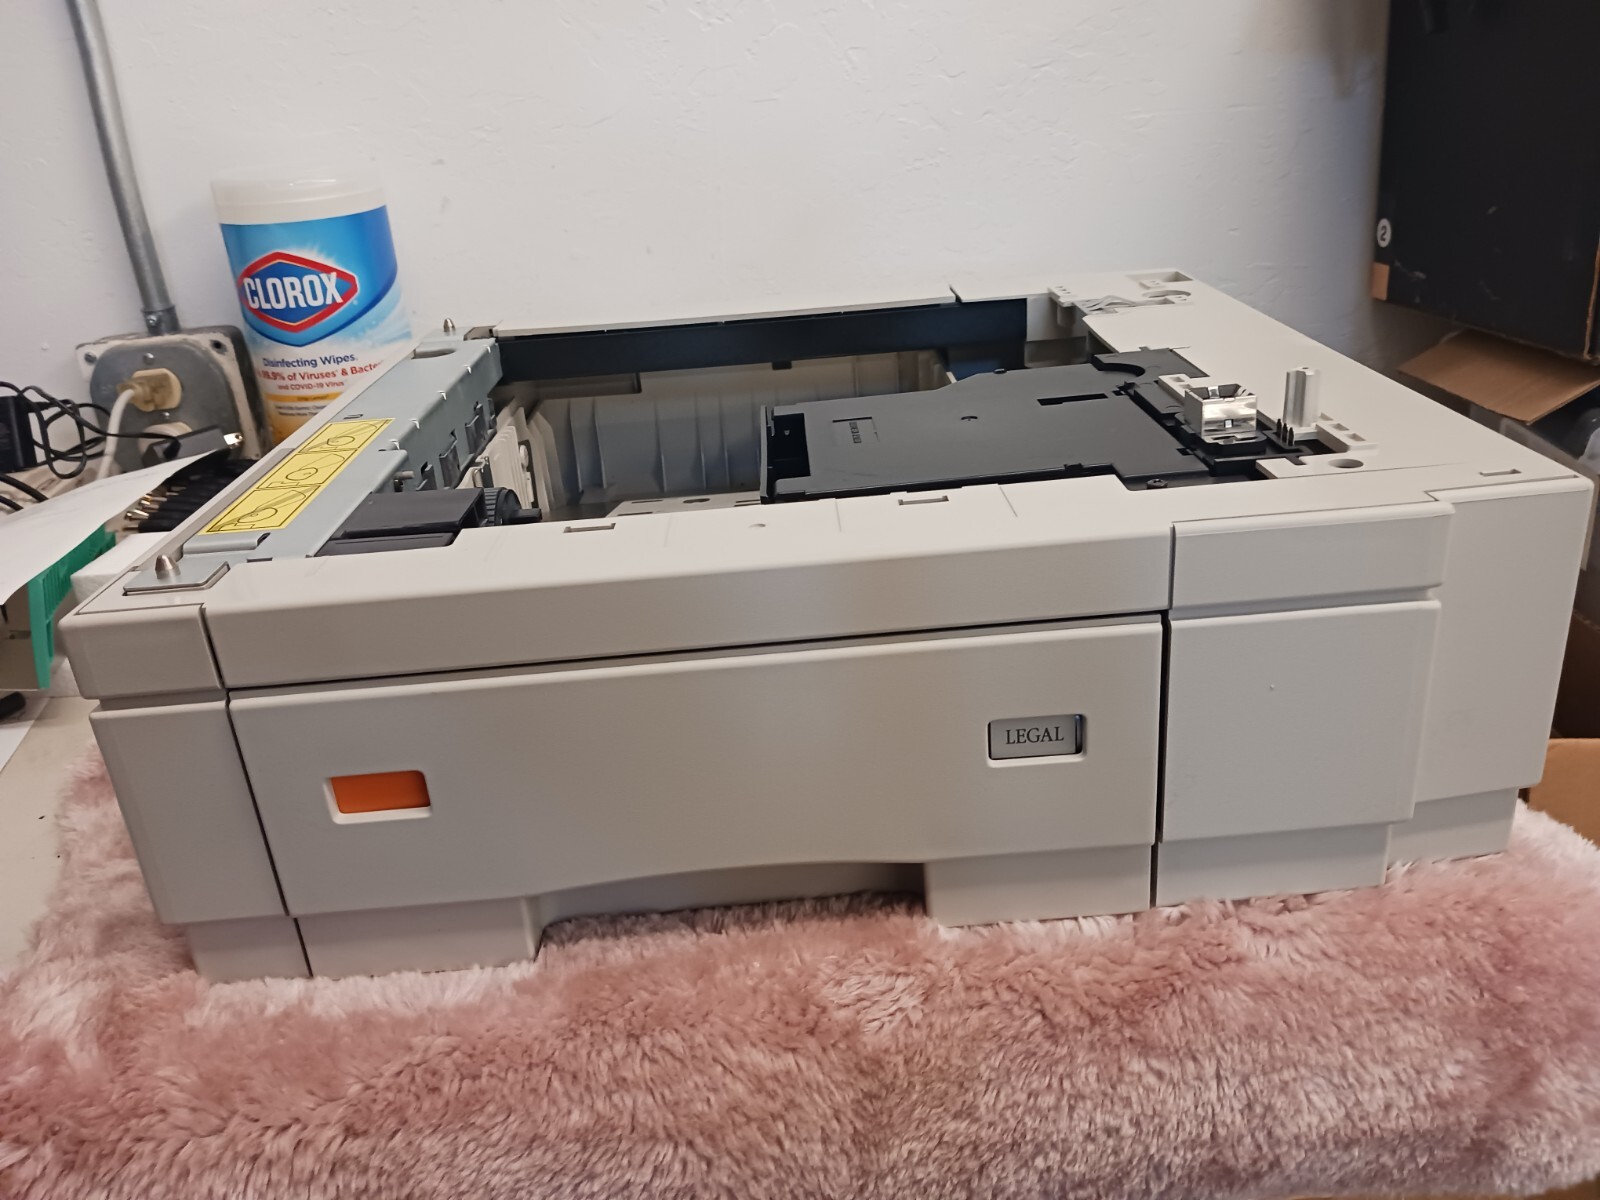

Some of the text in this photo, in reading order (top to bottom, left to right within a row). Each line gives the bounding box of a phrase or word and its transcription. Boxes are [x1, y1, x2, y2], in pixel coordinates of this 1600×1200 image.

[243, 271, 343, 310] CLOROX
[262, 353, 356, 368] Disinfecting Wipes
[287, 372, 297, 381] of
[341, 368, 349, 376] &
[290, 382, 324, 391] COVID-19
[1006, 727, 1064, 745] LEGAL
